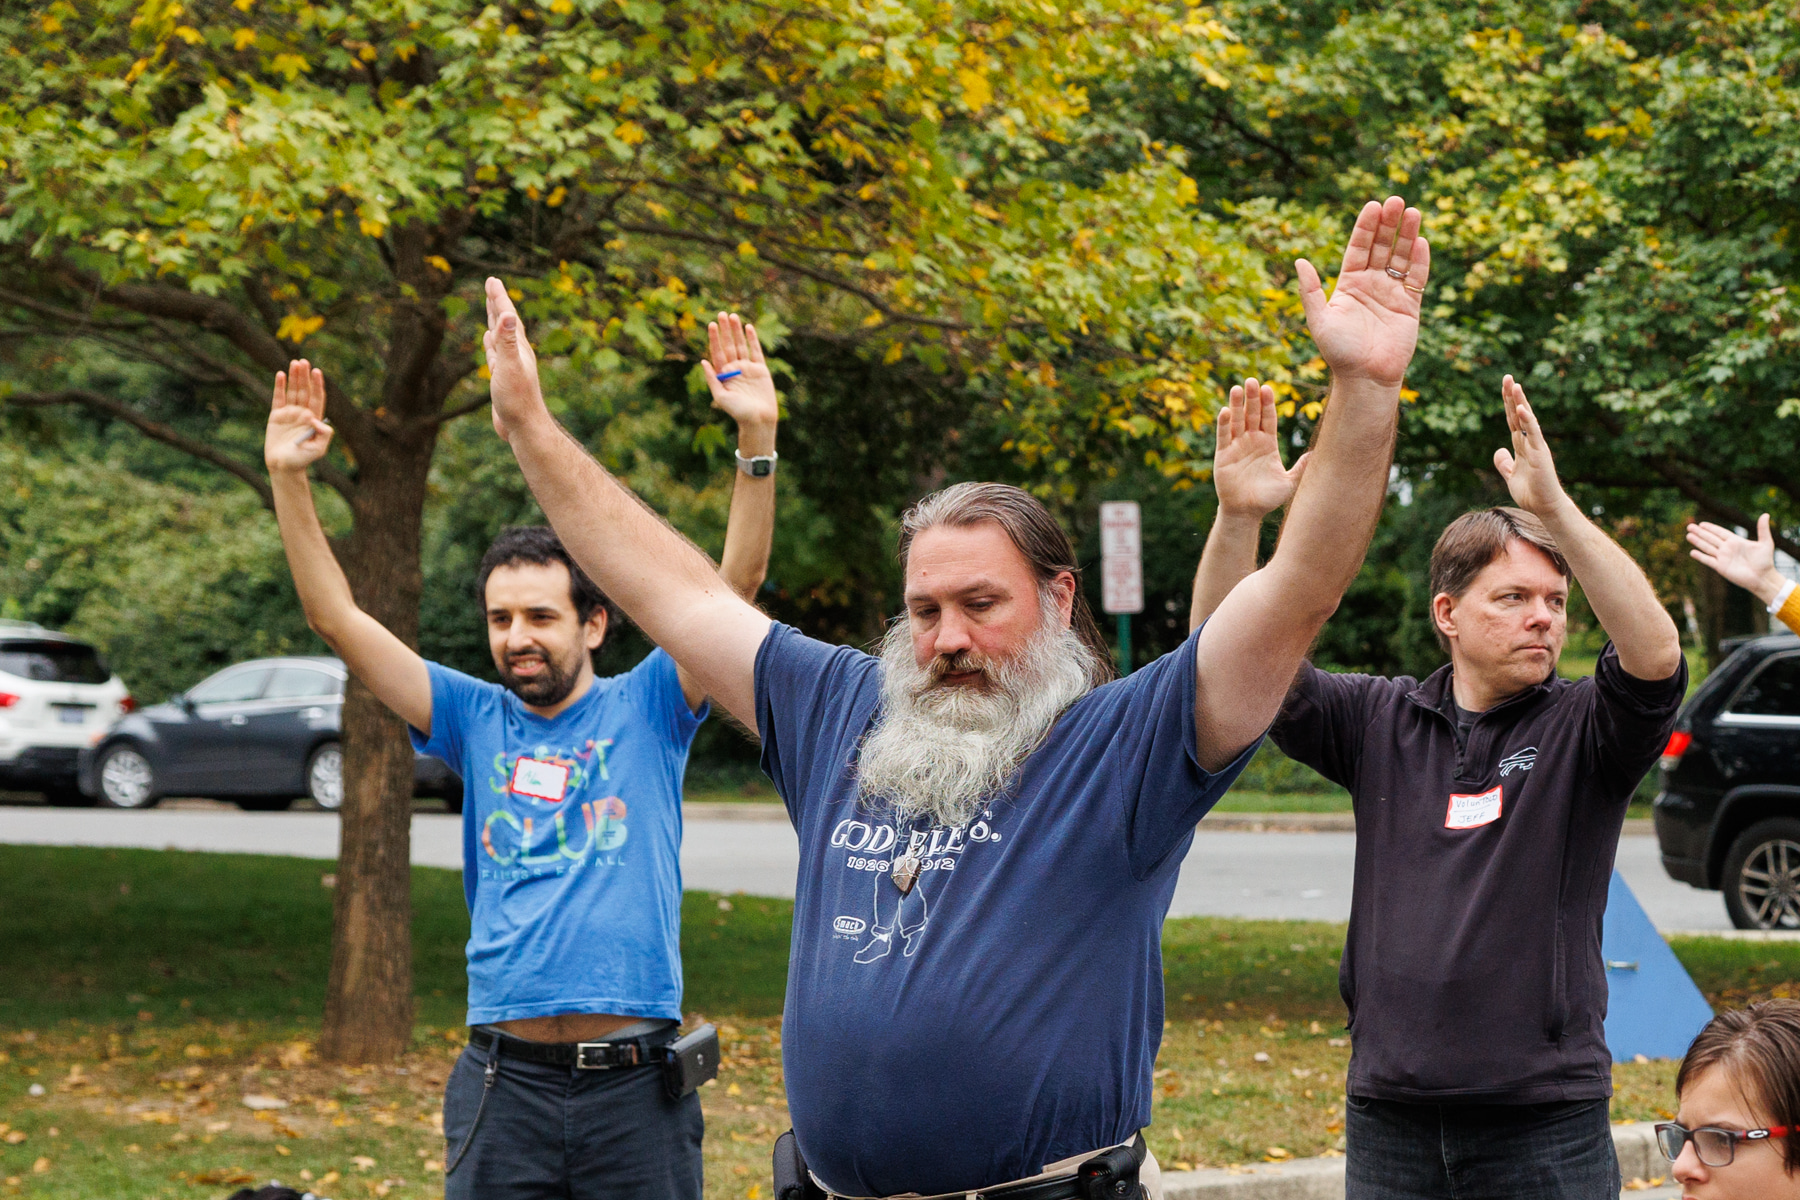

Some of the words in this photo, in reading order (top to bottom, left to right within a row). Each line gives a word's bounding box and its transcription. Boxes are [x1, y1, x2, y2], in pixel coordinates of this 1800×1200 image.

[481, 796, 627, 866] CLUB
[831, 819, 896, 854] GOD
[595, 855, 625, 867] ALL
[847, 856, 890, 872] 1926
